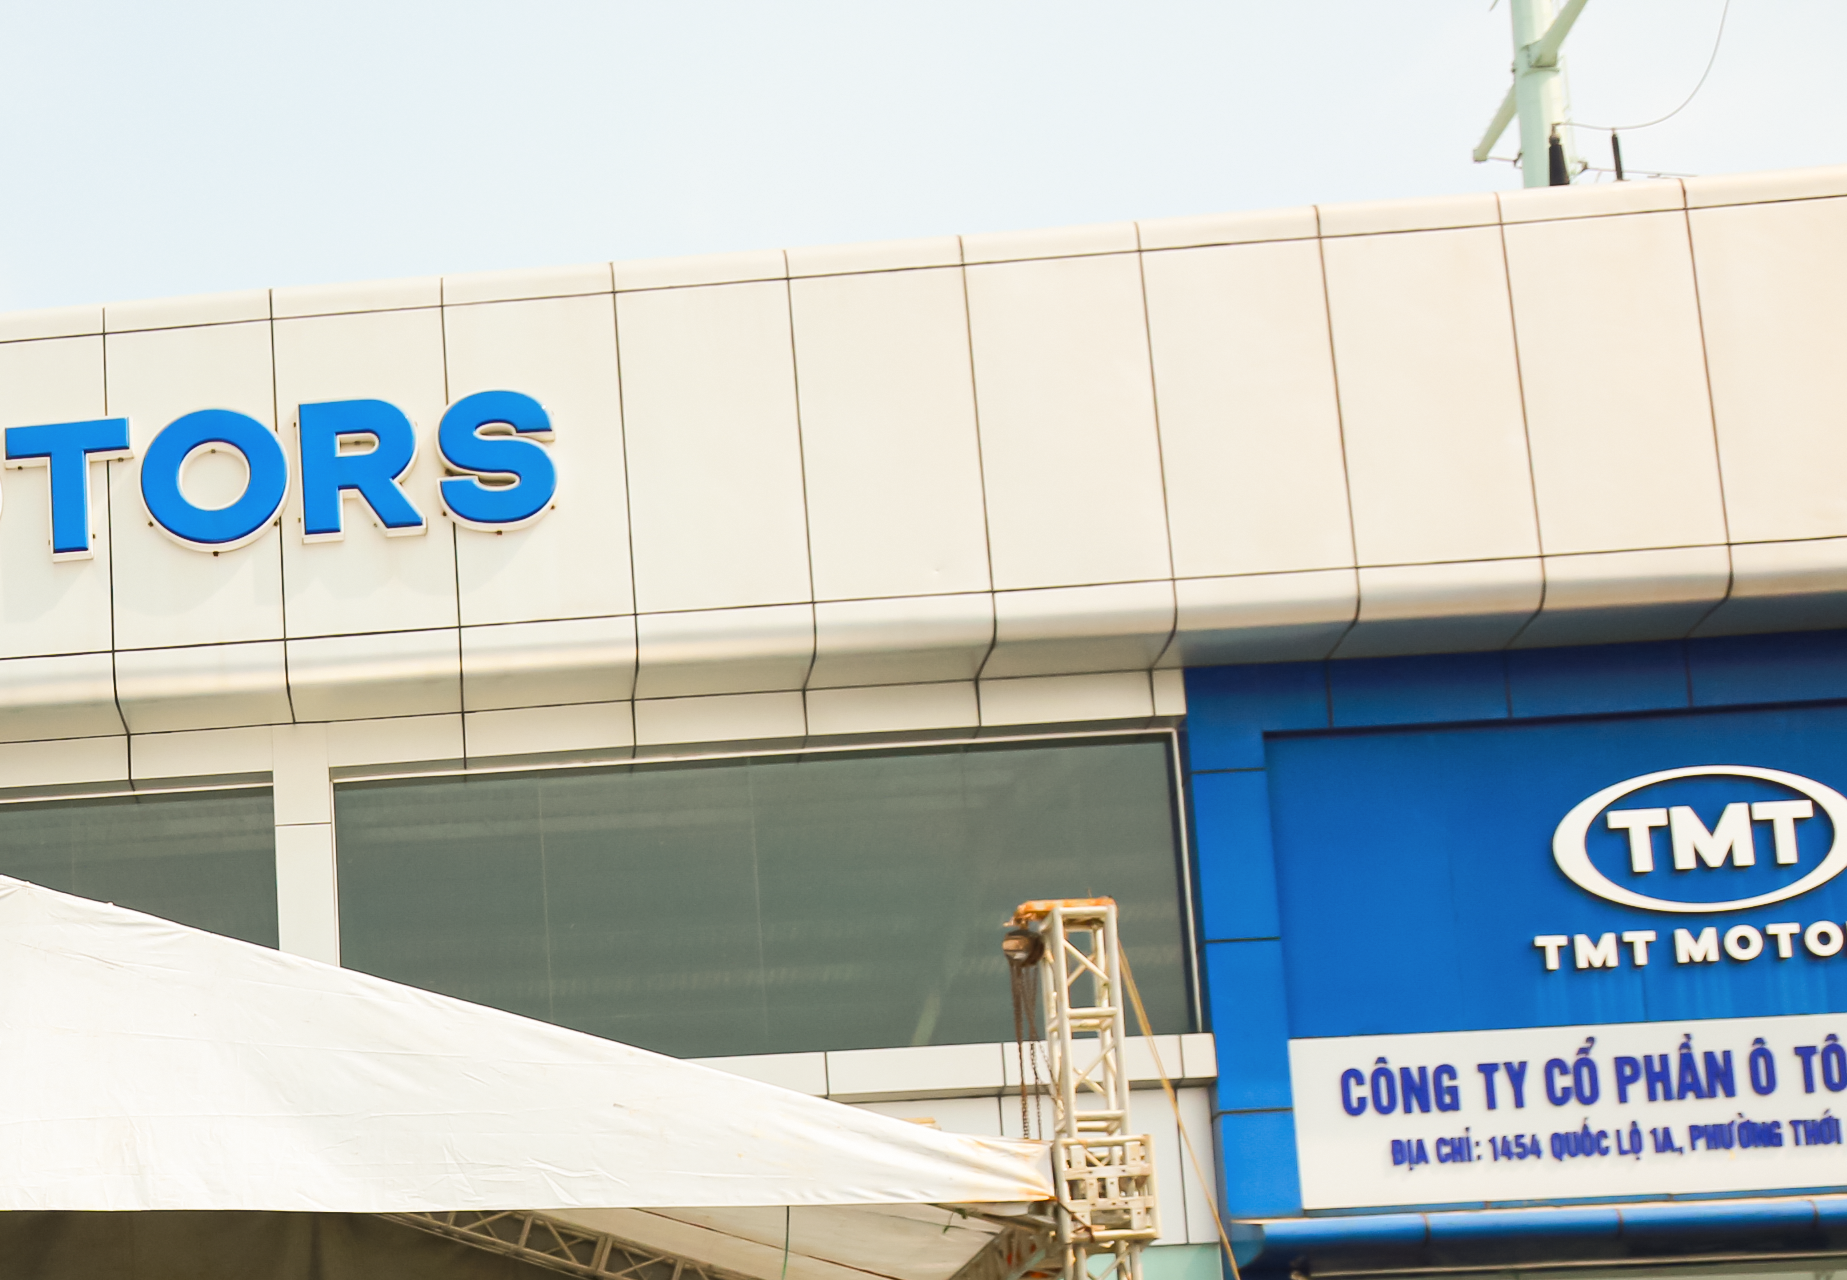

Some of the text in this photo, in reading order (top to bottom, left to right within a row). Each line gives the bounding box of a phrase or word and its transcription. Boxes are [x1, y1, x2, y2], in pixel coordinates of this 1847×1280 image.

[1606, 800, 1814, 874] TMT
[1534, 920, 1847, 971] TMT MOTO
[1340, 1033, 1847, 1116] CÔNG TY CỔ PHẦN Ô TÔ
[1488, 1133, 1544, 1162] 1454
[1550, 1117, 1610, 1161] QUỐC
[1616, 1120, 1643, 1160] LỘ
[1688, 1112, 1783, 1150] PHƯỜNG
[1789, 1108, 1843, 1147] THỚI
